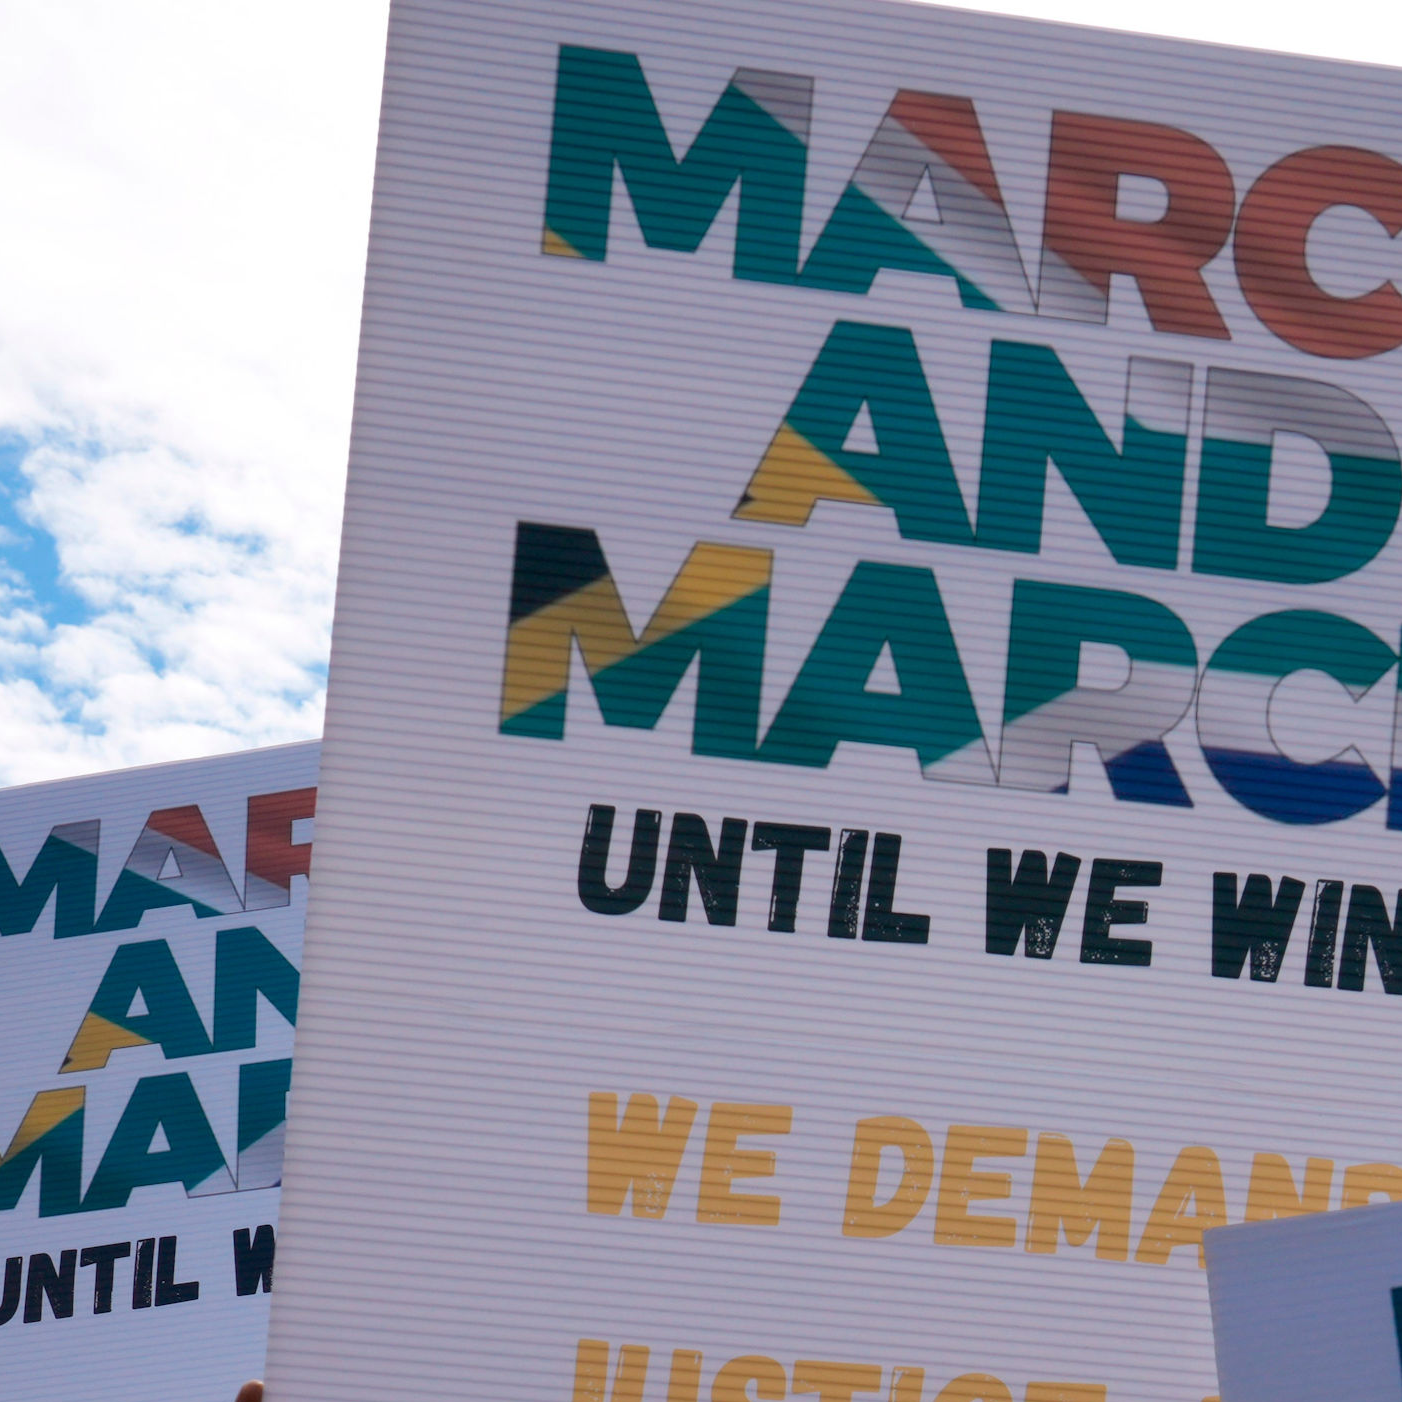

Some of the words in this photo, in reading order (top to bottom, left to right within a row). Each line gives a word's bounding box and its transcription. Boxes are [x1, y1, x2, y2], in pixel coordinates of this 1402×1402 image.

[576, 803, 931, 944] UNTIL
[985, 845, 1163, 967] WE
[587, 1091, 793, 1226] WE
